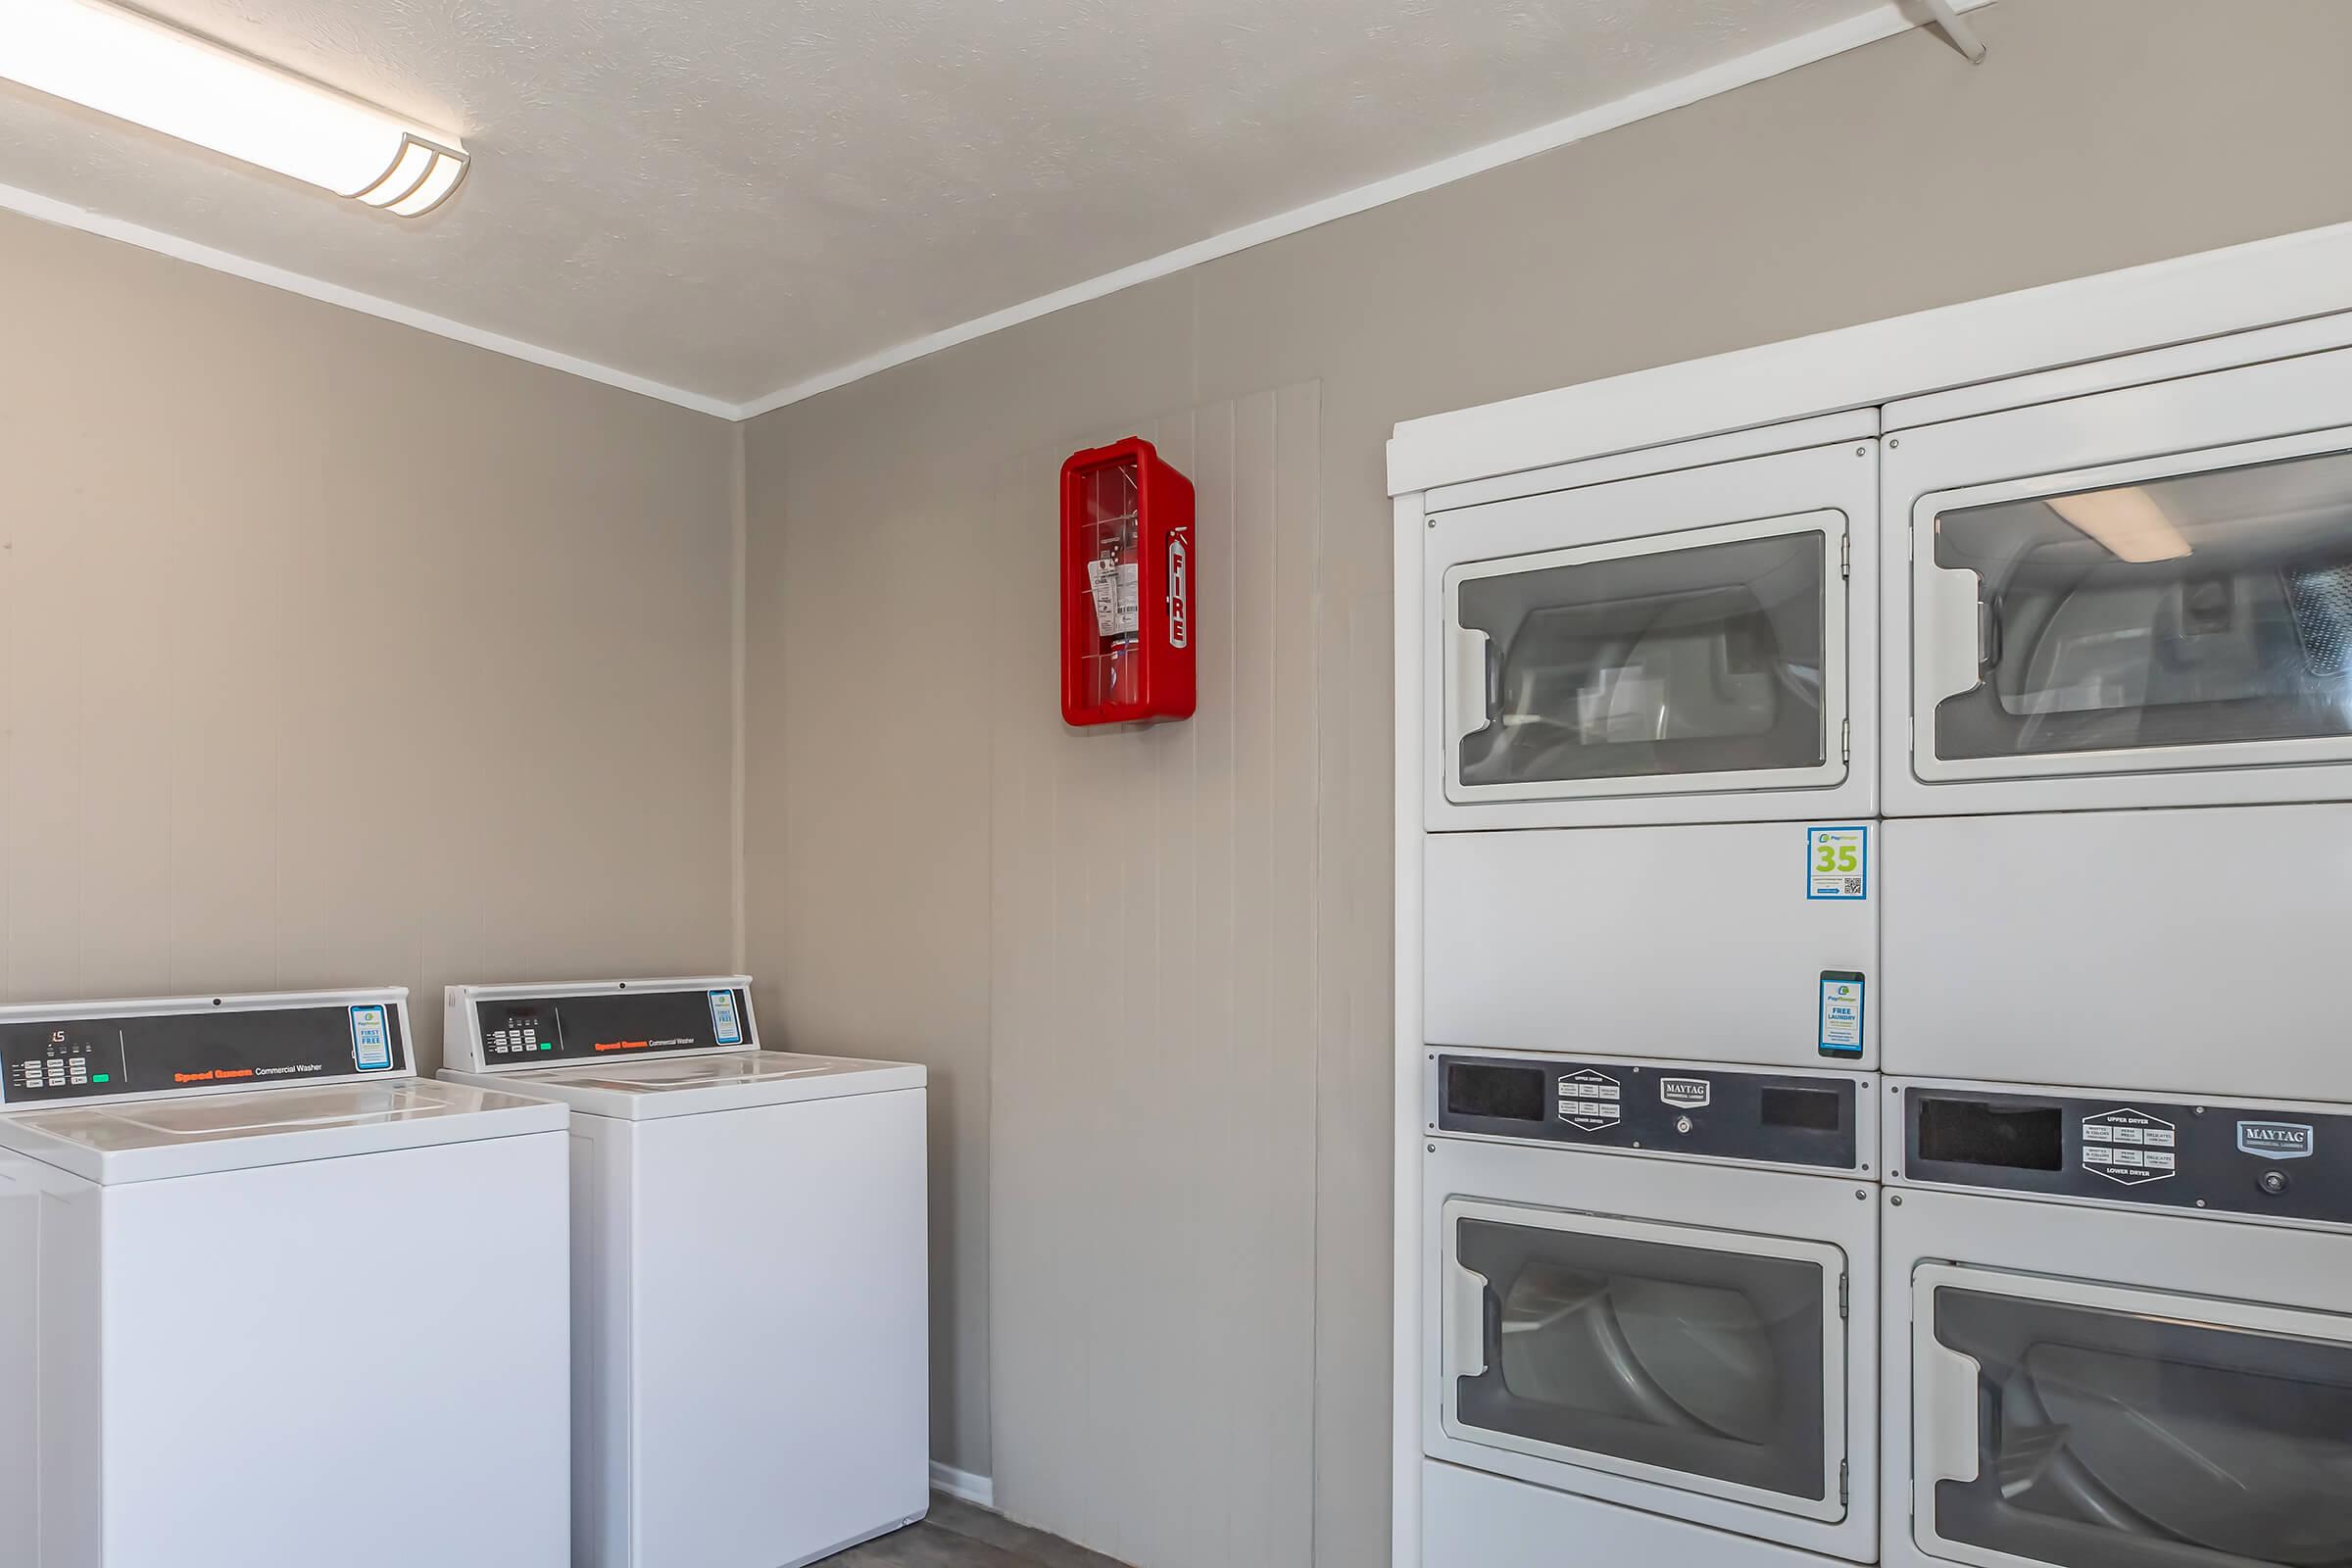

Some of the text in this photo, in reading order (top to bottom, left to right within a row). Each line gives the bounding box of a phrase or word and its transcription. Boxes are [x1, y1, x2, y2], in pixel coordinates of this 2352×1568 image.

[1172, 554, 1185, 642] FIRE
[1816, 845, 1858, 872] 35
[174, 1063, 322, 1083] Speed Queen Commercial Washer
[1666, 1084, 1704, 1095] MAYTAG
[2246, 1128, 2305, 1143] MAYTAG
